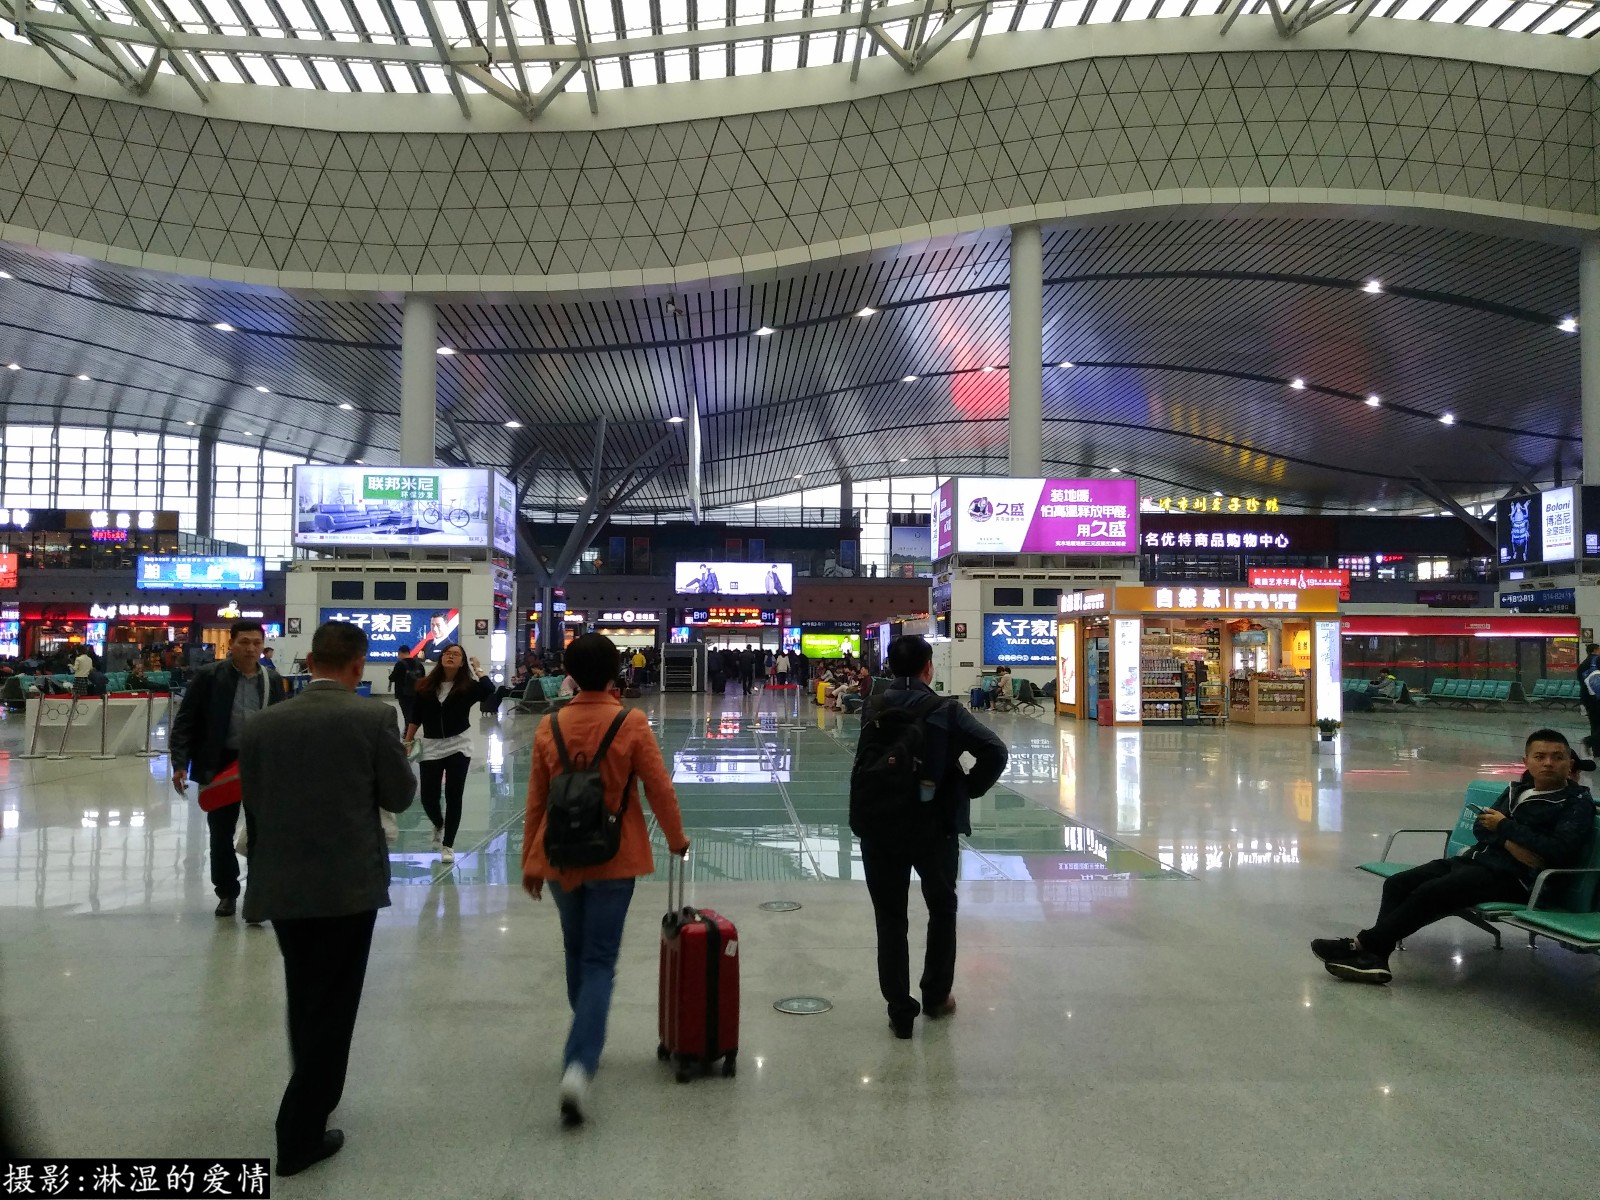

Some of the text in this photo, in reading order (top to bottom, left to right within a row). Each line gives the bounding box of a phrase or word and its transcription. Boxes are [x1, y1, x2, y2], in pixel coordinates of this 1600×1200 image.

[368, 476, 434, 491] 联邦米尼
[400, 491, 434, 499] 环保沙发
[995, 503, 1025, 517] 久盛
[1545, 500, 1571, 512] Boloni
[1545, 512, 1571, 528] 博洛尼
[1077, 520, 1127, 538] 用久盛
[1139, 532, 1289, 548] 名优特商品购物中心
[1512, 594, 1534, 603] B12-B13
[693, 611, 708, 620] B10
[761, 612, 775, 620] B11
[371, 633, 396, 641] CASA
